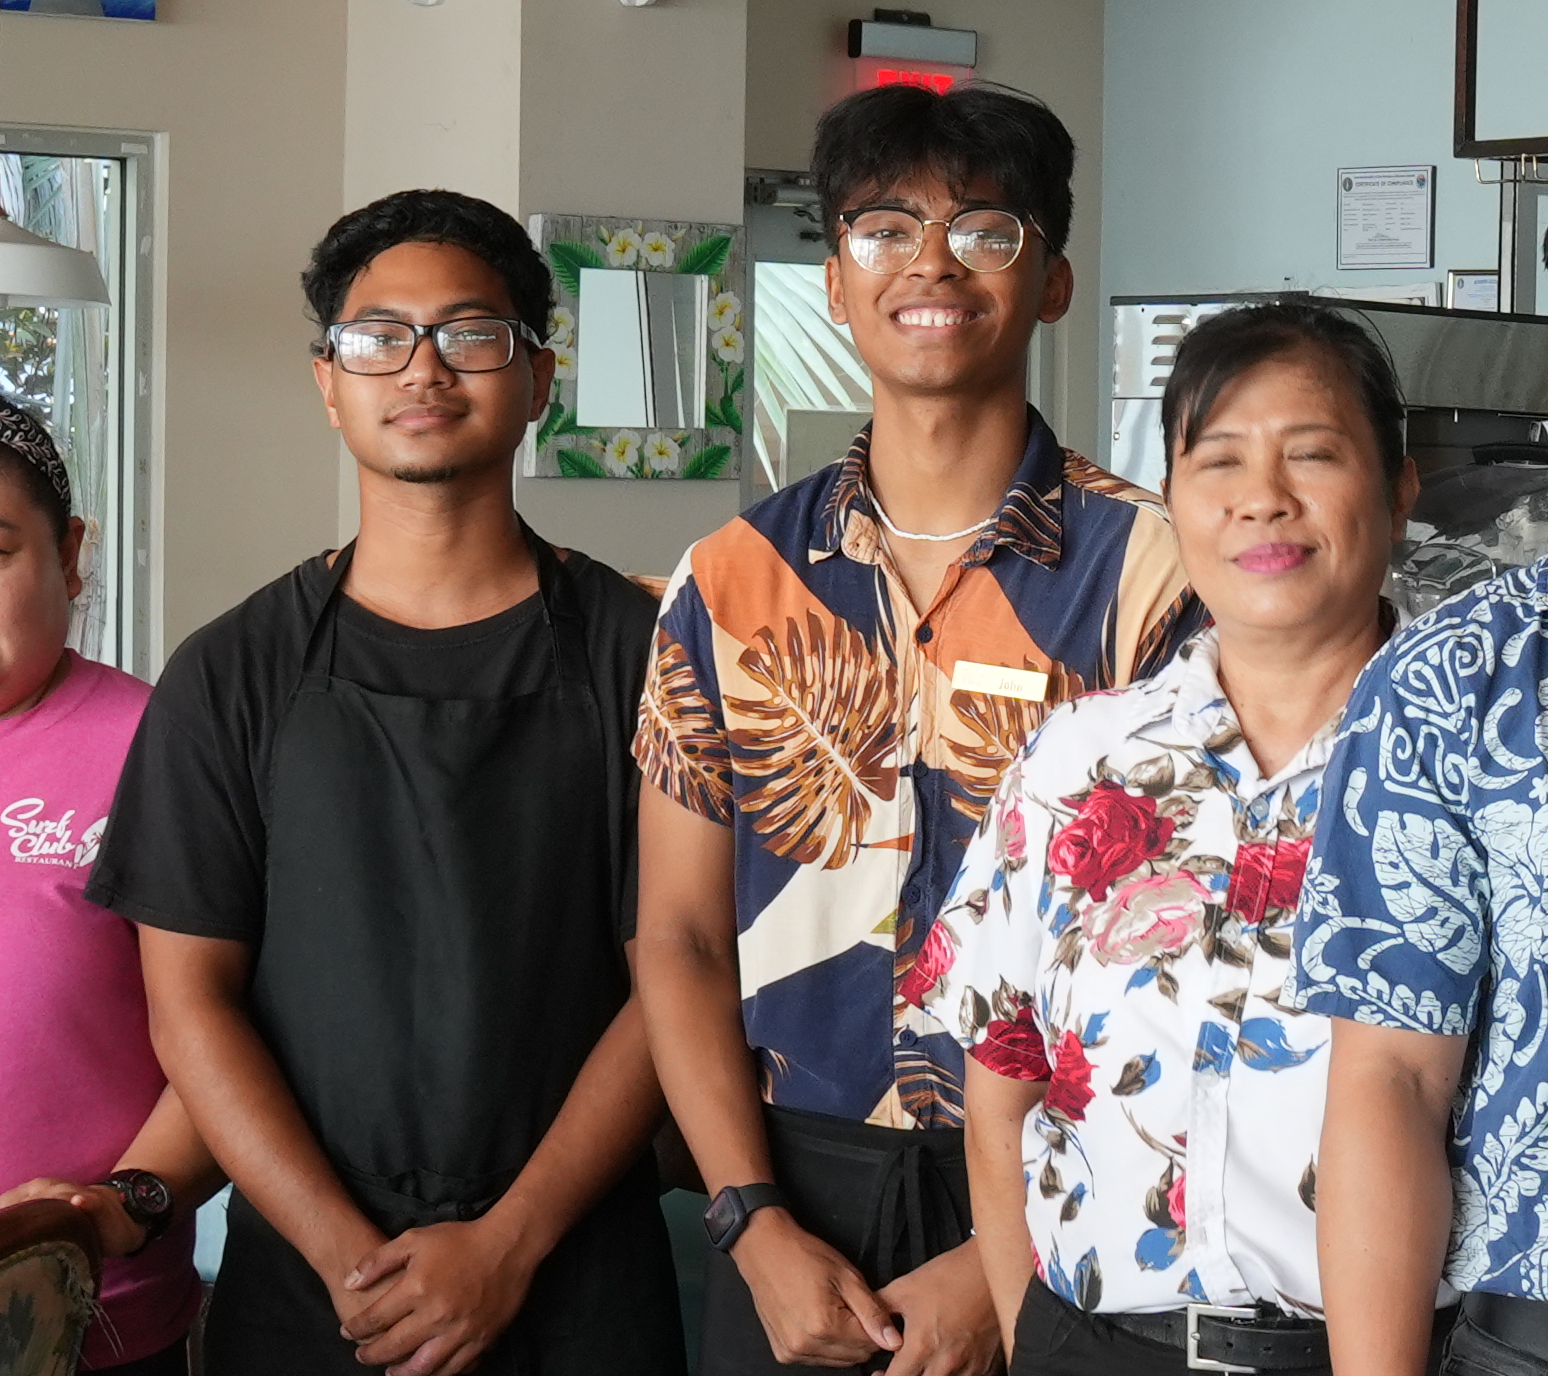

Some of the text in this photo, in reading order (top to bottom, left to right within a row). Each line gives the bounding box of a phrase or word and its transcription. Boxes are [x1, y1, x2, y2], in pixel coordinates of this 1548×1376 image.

[998, 678, 1023, 692] John
[0, 797, 76, 838] Surf
[10, 830, 76, 858] Club
[14, 856, 79, 869] RESTAURANT
